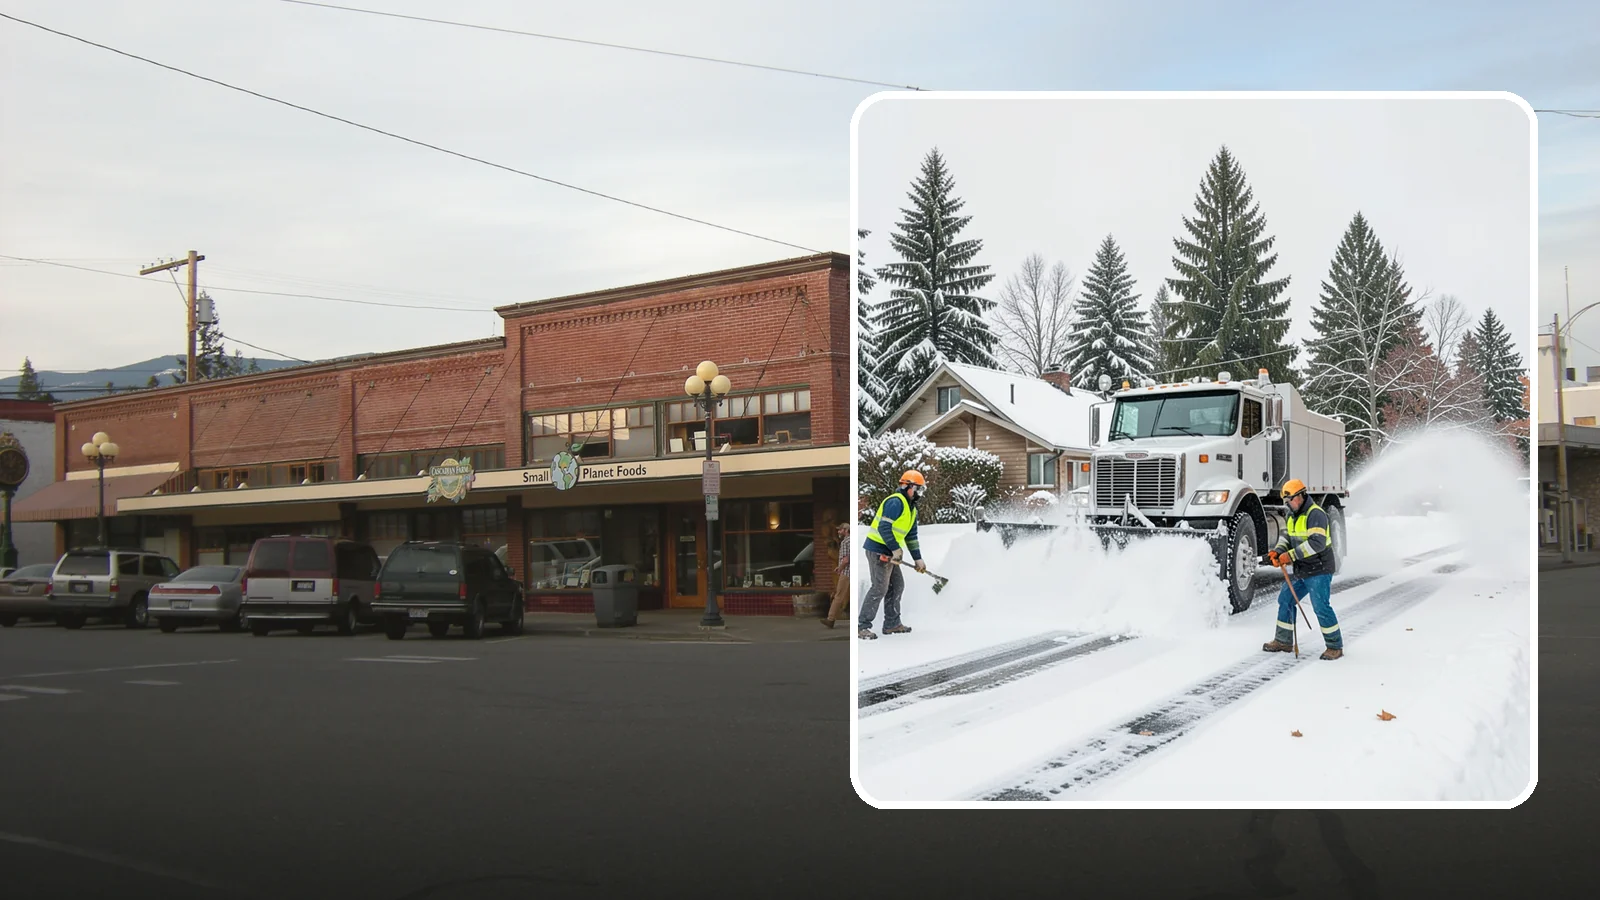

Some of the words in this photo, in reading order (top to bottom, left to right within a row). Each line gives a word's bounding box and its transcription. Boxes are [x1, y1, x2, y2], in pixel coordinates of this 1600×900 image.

[523, 471, 549, 483] Small
[583, 467, 614, 479] Planet
[617, 464, 647, 477] Foods
